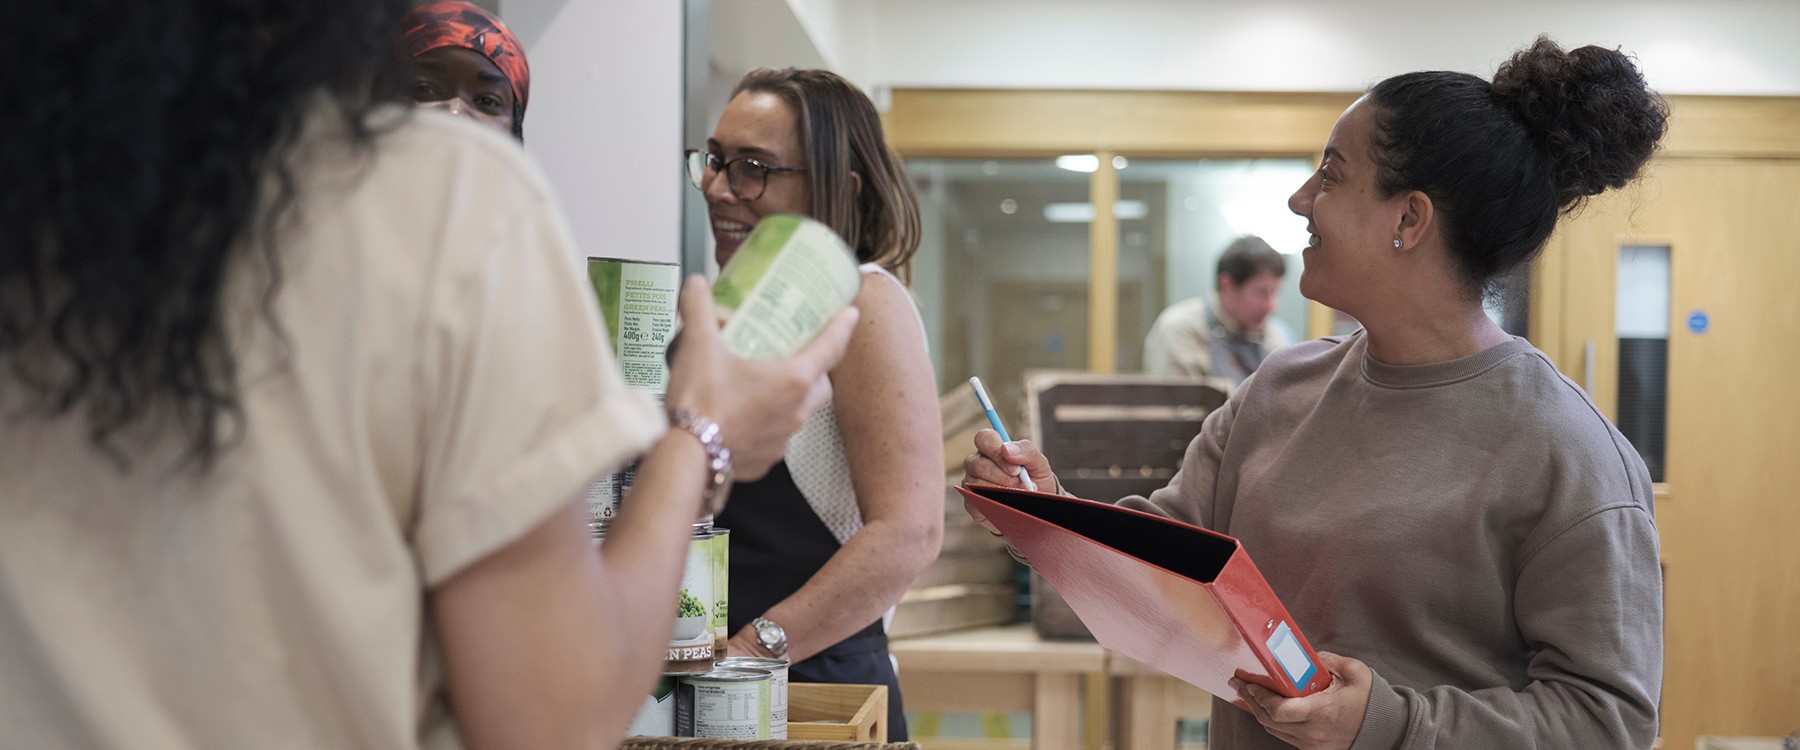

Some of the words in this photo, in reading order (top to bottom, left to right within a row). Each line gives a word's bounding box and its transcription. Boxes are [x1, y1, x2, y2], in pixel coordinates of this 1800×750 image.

[624, 331, 639, 342] 400g
[652, 332, 664, 343] 240g
[683, 646, 711, 660] PEAS
